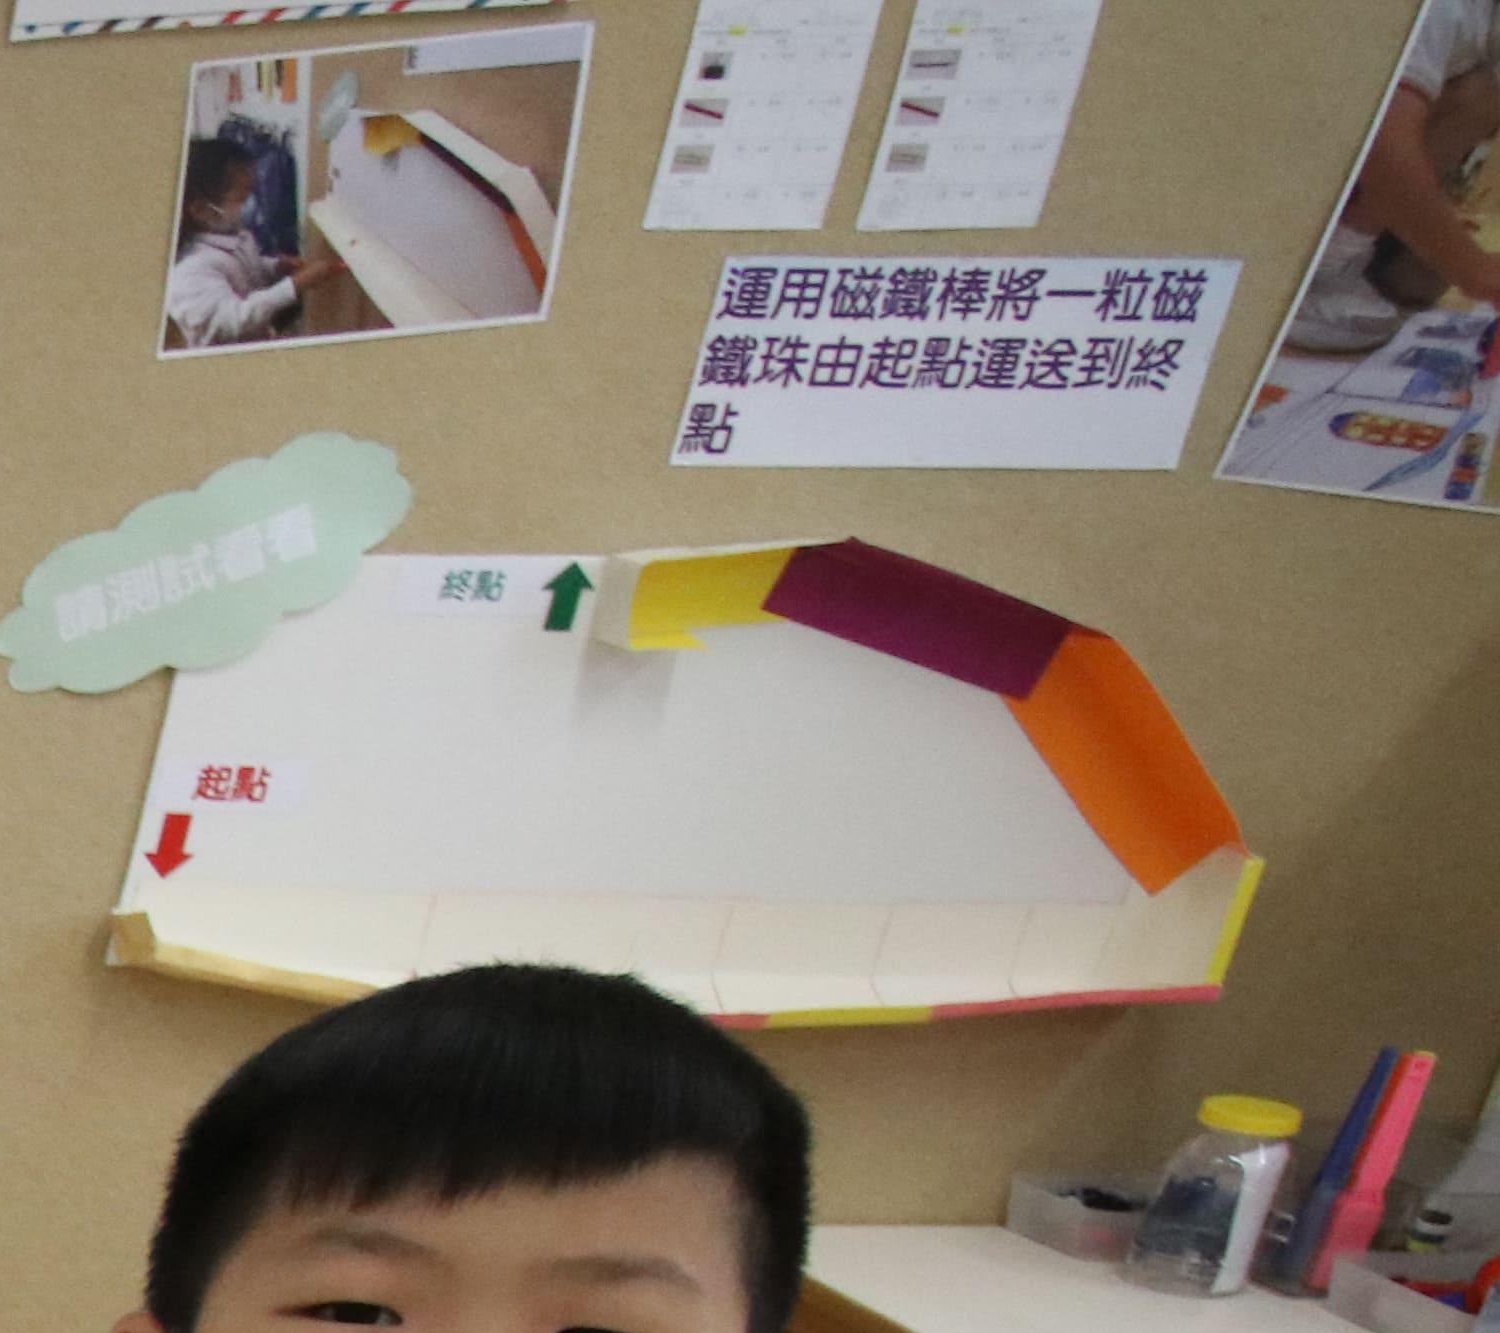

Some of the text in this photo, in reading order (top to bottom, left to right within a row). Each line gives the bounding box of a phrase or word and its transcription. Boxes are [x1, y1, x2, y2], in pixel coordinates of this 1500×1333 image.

[714, 265, 1209, 324] 運用磁鐵棒將一粒磁
[698, 334, 1186, 392] 鐵珠由起點運送到終
[678, 402, 740, 456] 點
[437, 568, 507, 602] 終點
[191, 764, 273, 804] 起點
